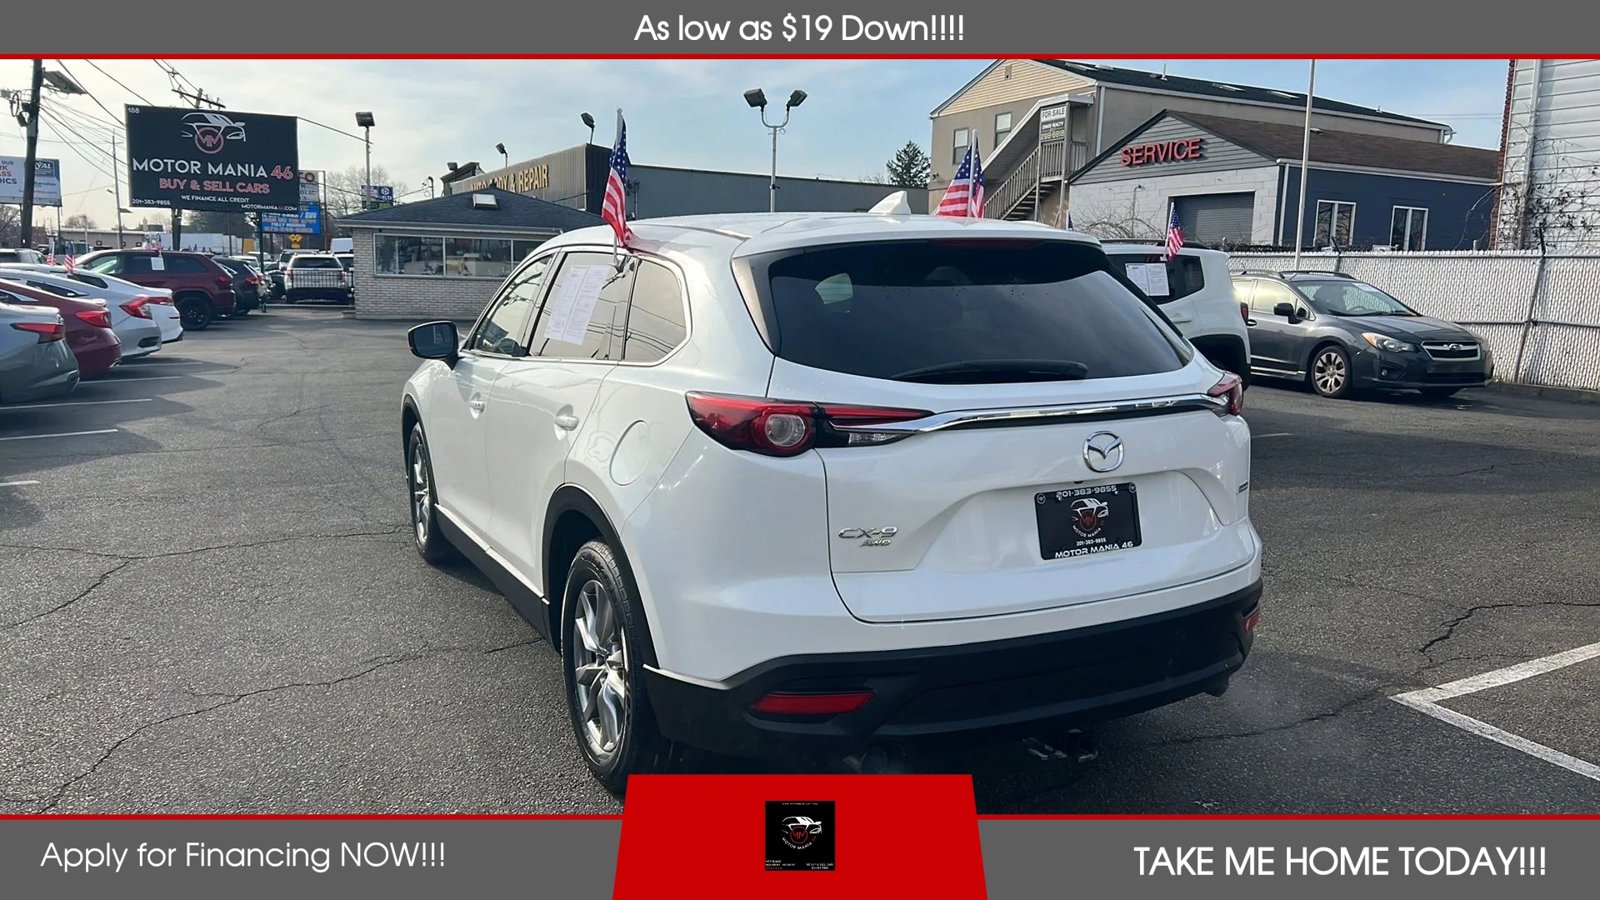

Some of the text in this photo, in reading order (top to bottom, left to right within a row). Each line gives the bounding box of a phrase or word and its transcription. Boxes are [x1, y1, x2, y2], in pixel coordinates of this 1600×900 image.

[1042, 107, 1065, 119] FOR SALE
[1120, 136, 1201, 166] SERVICE
[132, 158, 294, 180] MOTOR MANIA 46
[159, 178, 270, 194] BUY & SELL CARS
[518, 164, 549, 193] REPAIR
[1055, 485, 1117, 499] 201-383-9855
[838, 526, 898, 539] CX-9
[860, 539, 892, 548] AWD
[1054, 547, 1089, 558] MOTOR
[1090, 543, 1120, 553] MANIA
